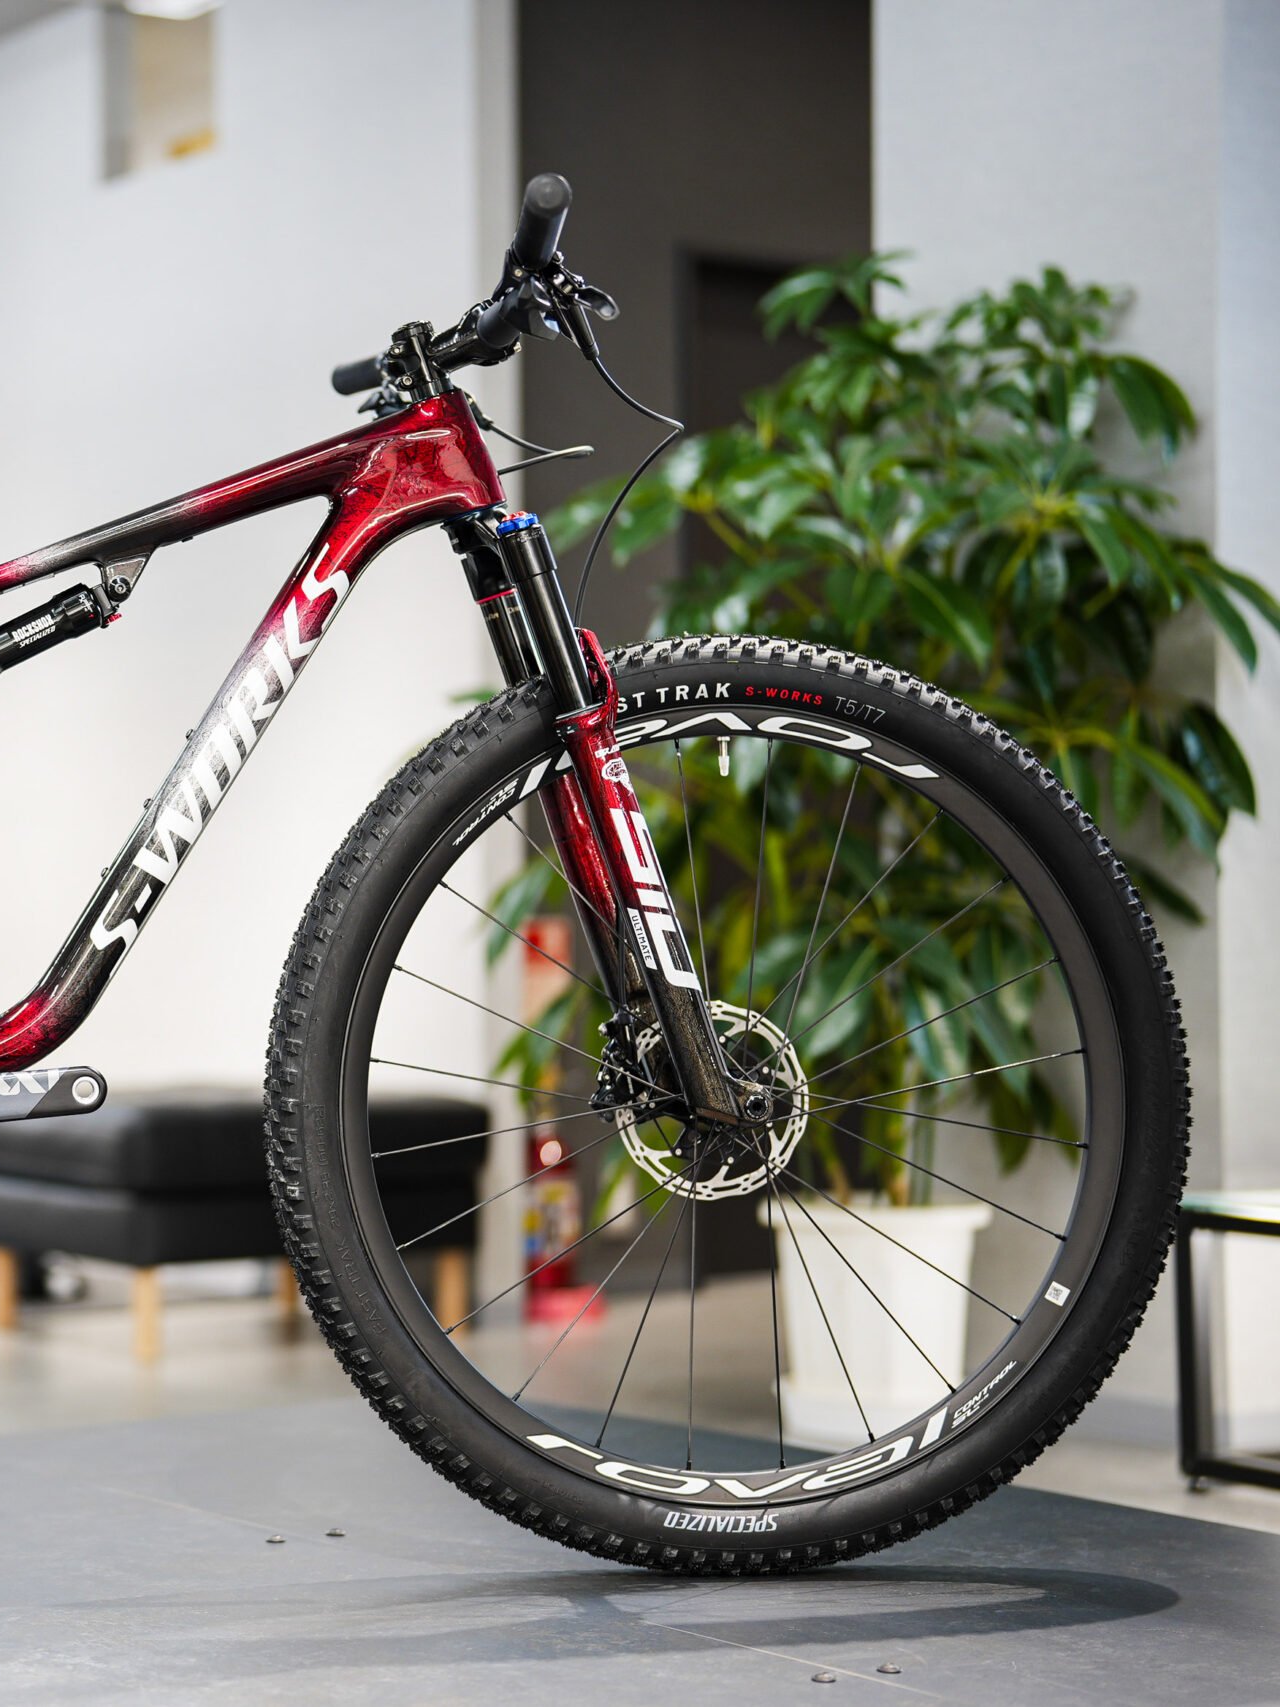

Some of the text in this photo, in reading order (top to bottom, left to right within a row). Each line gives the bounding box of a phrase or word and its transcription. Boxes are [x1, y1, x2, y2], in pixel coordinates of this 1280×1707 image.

[11, 614, 55, 643] ROCKSHOX
[19, 625, 56, 649] SPECIALIZED
[616, 682, 886, 725] ST TRAK S-WORKS T5/T7
[89, 543, 351, 955] S-WORKS
[452, 787, 516, 846] CONTROL
[631, 914, 652, 962] ULTIMATE
[953, 1360, 1018, 1419] CONTROL
[526, 1406, 948, 1498] roval
[663, 1510, 779, 1533] SPECIALIZED
